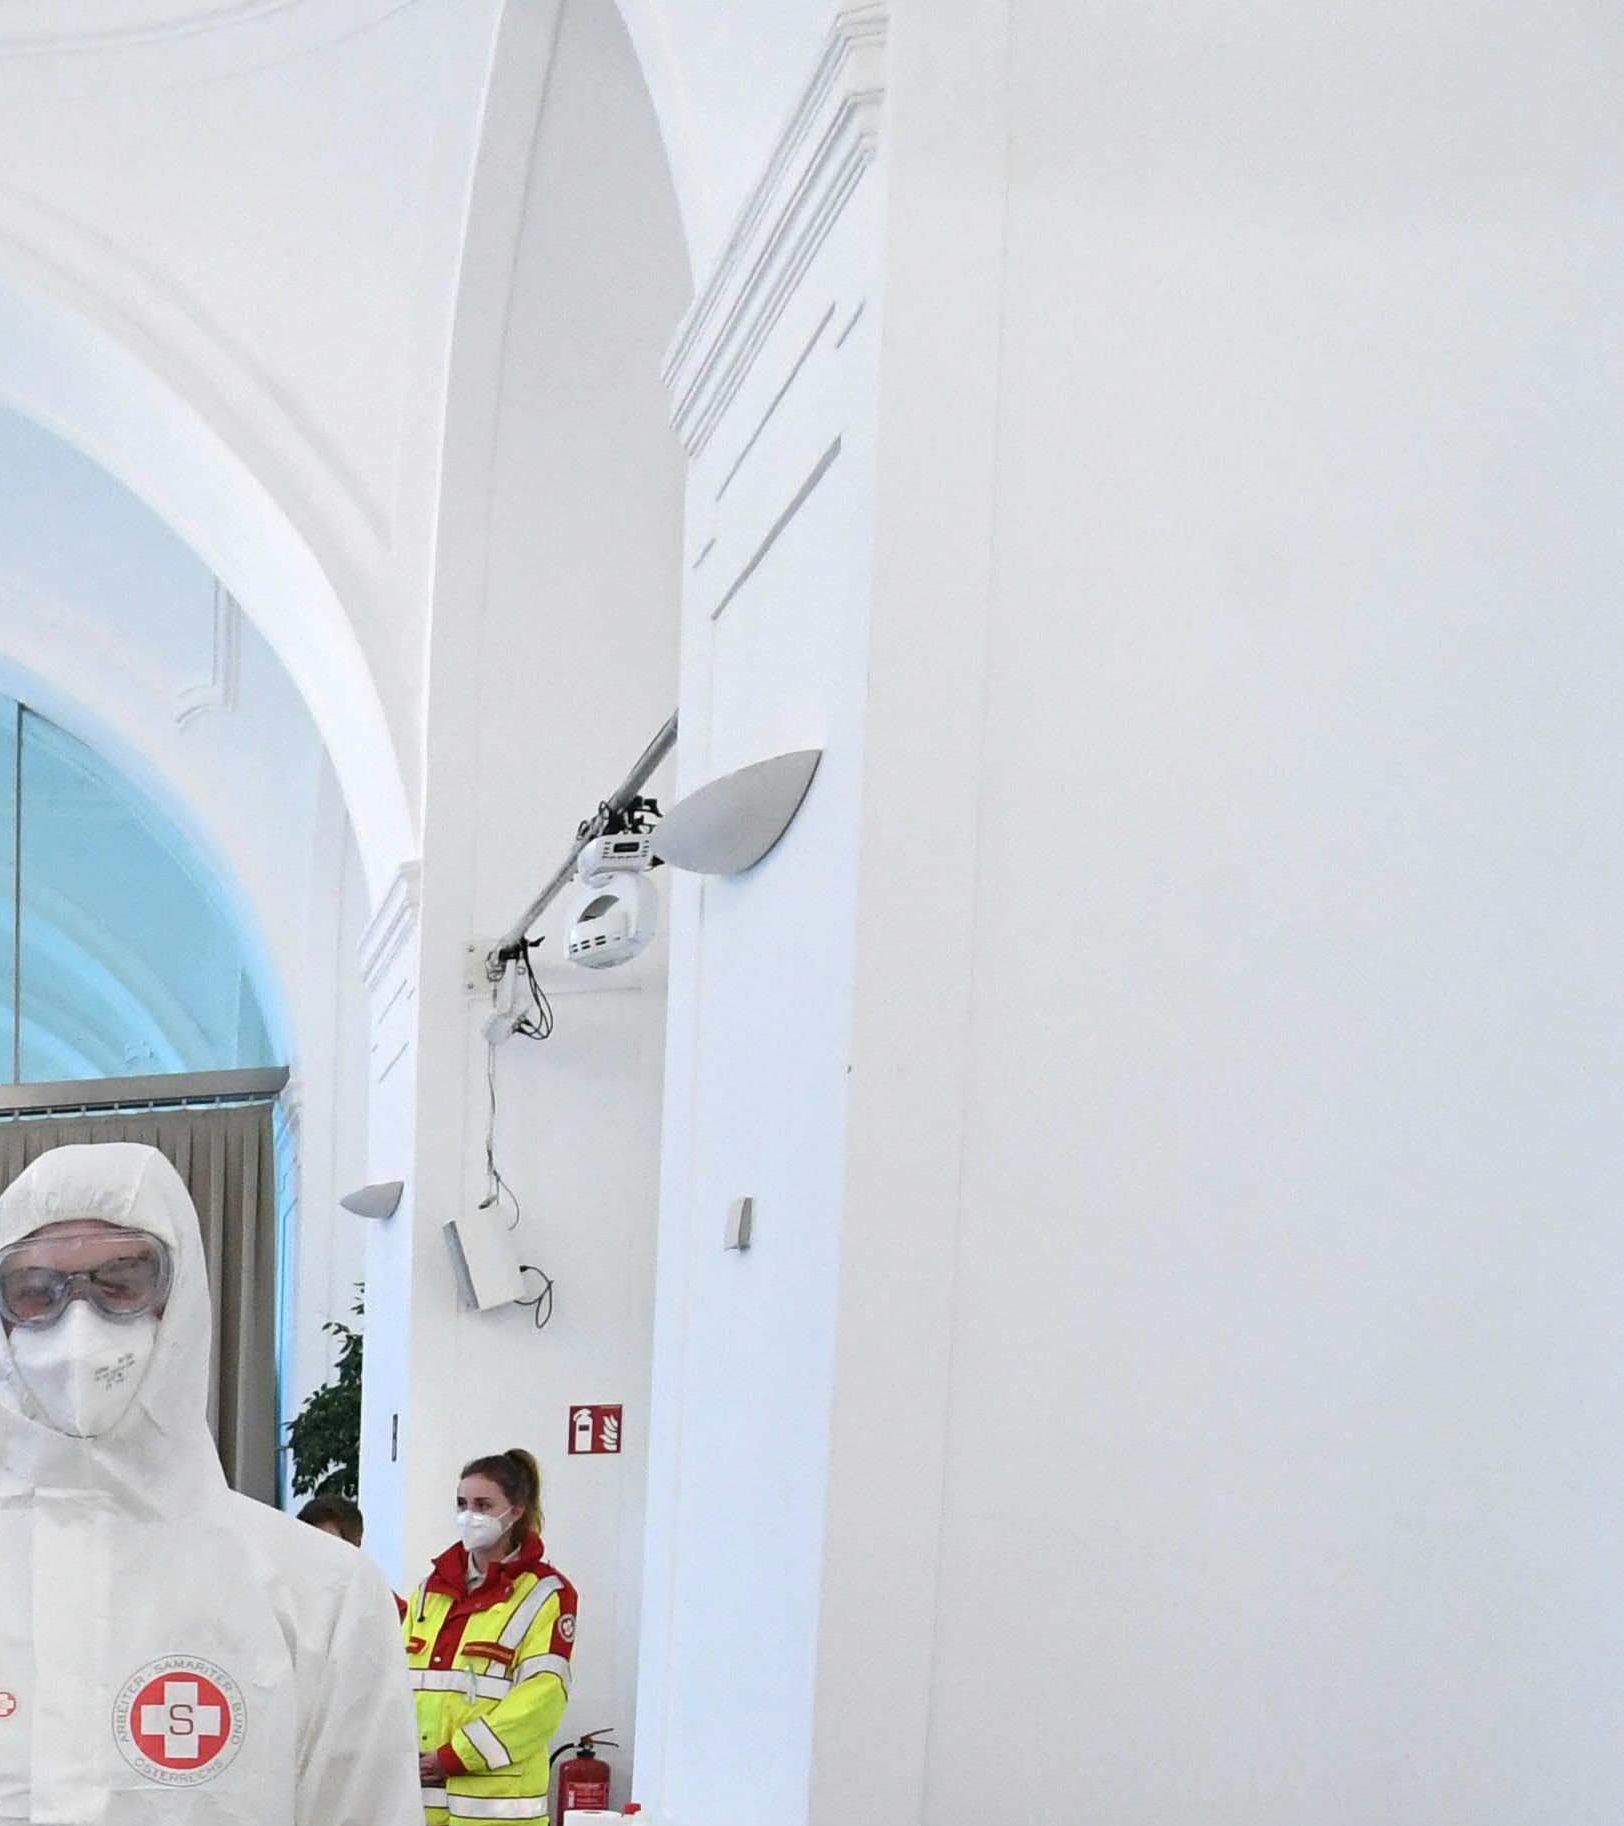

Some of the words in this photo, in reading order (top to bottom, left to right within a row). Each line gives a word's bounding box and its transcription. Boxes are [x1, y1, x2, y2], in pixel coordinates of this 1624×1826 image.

[116, 1676, 146, 1743] ARBEITER
[153, 1660, 233, 1693] SAMARITER
[231, 1702, 243, 1745] BUND
[169, 1704, 194, 1735] S
